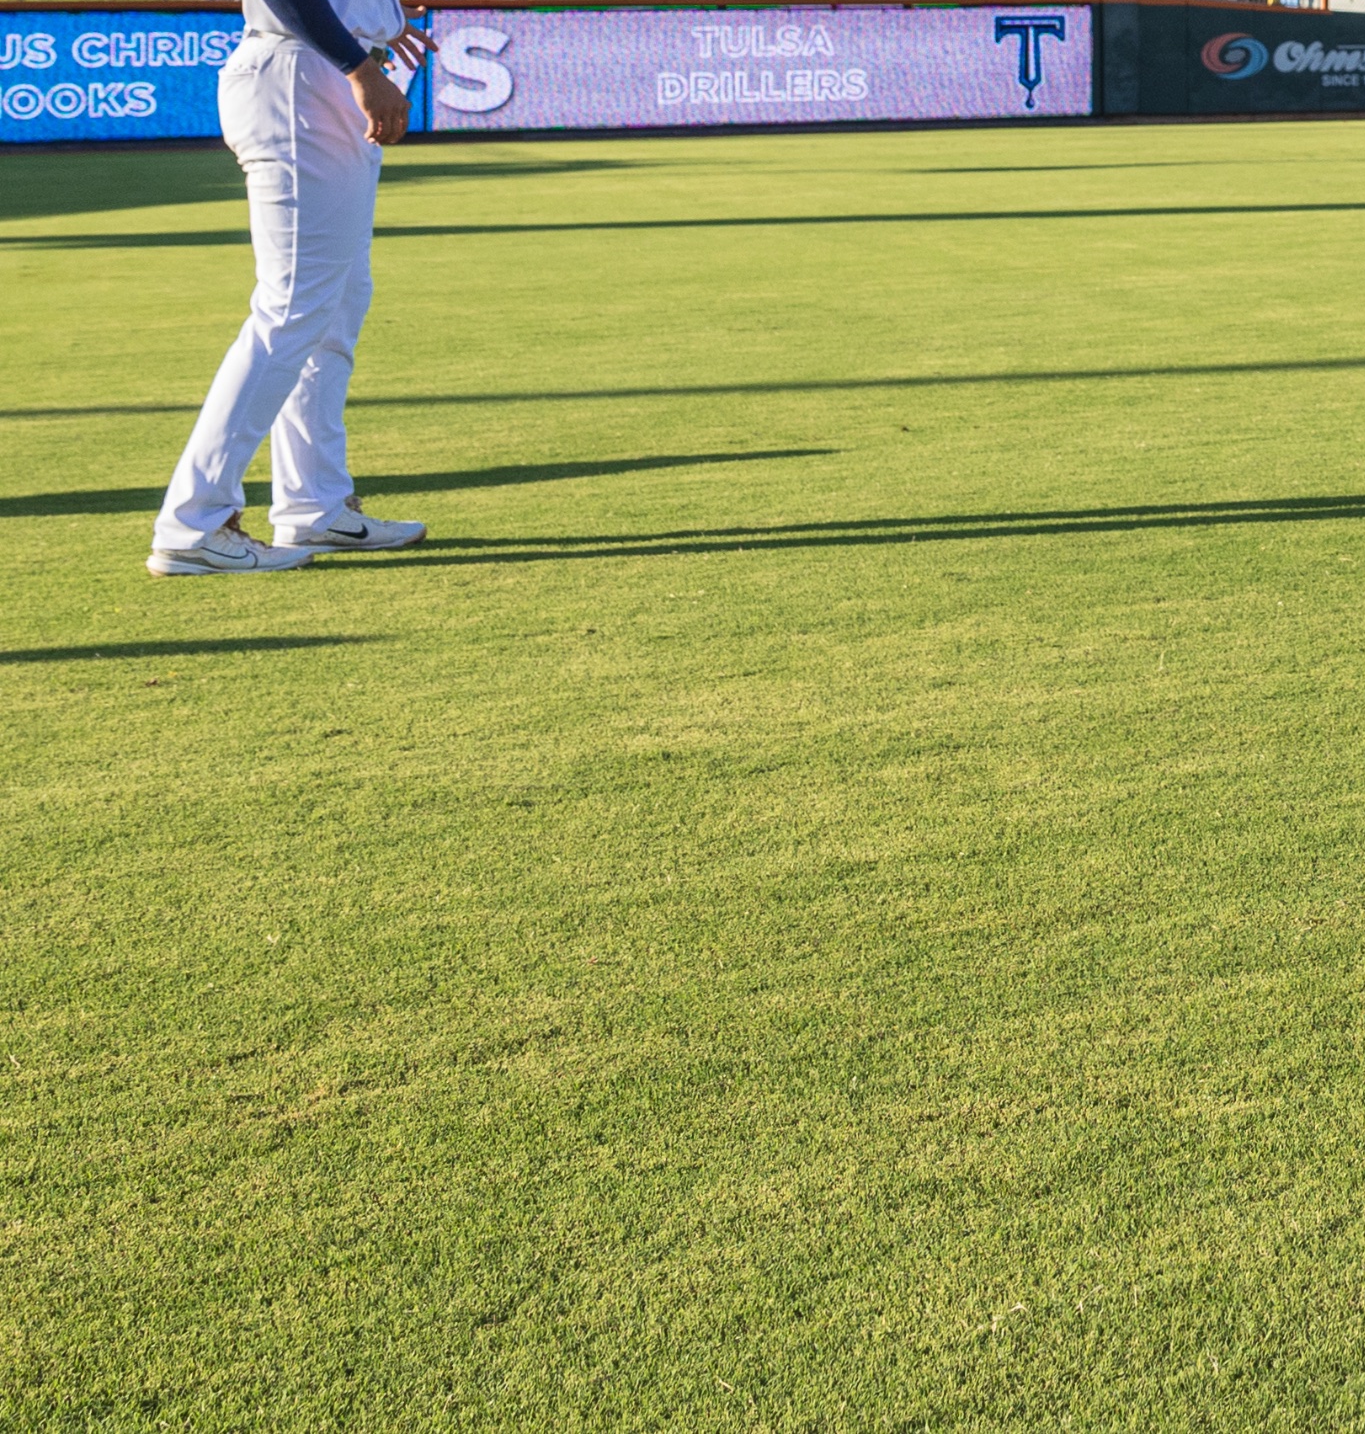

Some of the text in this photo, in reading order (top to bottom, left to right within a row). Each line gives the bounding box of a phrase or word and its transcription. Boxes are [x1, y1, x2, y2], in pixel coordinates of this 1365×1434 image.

[72, 31, 244, 68] CHRIS
[692, 25, 834, 59] TULSA
[657, 69, 869, 105] DRILLERS
[1322, 74, 1360, 86] SINCE
